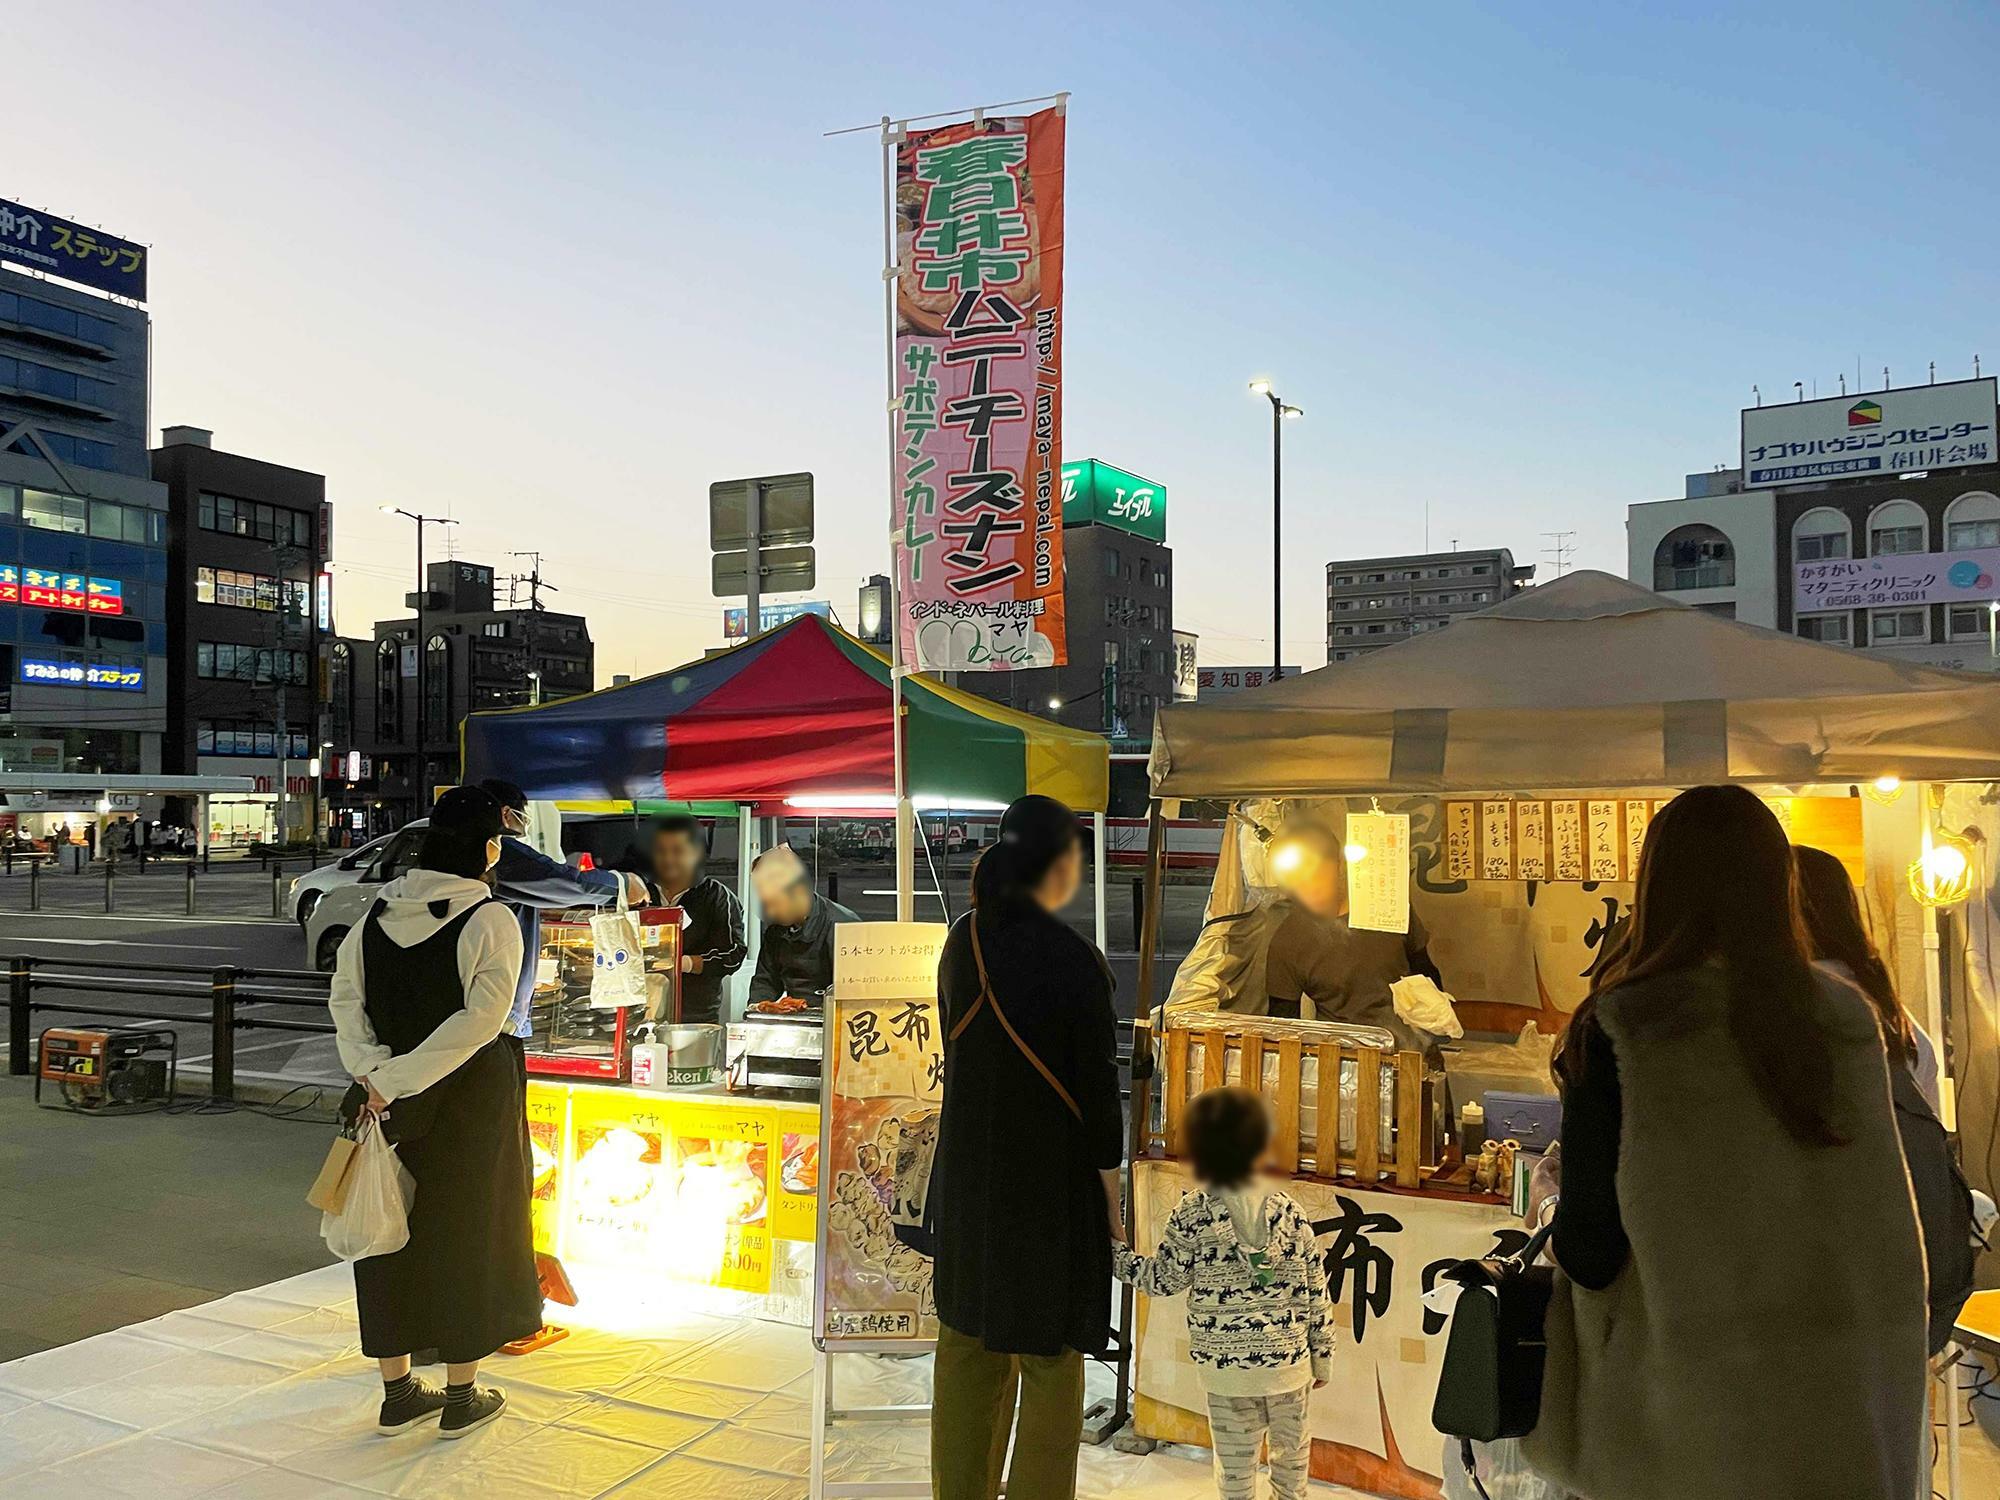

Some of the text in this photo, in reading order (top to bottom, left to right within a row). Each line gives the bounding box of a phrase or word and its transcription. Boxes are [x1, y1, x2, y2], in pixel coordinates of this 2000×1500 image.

[50, 225, 143, 273] ステップ
[1034, 308, 1057, 588] http://maya-nepal.com
[1748, 422, 1989, 463] ナゴヤハウジングセンター
[902, 344, 940, 582] サボテンカレー
[1889, 442, 1988, 470] 春日井会場
[1107, 487, 1155, 522] エイブル
[1800, 564, 1862, 579] かすがい
[1800, 574, 1937, 595] マタニティクリニック
[909, 598, 1046, 619] インド・ネパール料理
[988, 620, 1029, 638] マヤ
[1489, 820, 1501, 848] もも
[1595, 821, 1612, 853] つくね
[531, 1103, 557, 1118] マヤ
[632, 1112, 660, 1129] マヤ
[735, 1120, 765, 1137] マヤ
[827, 1314, 910, 1335] 国産鶏使用
